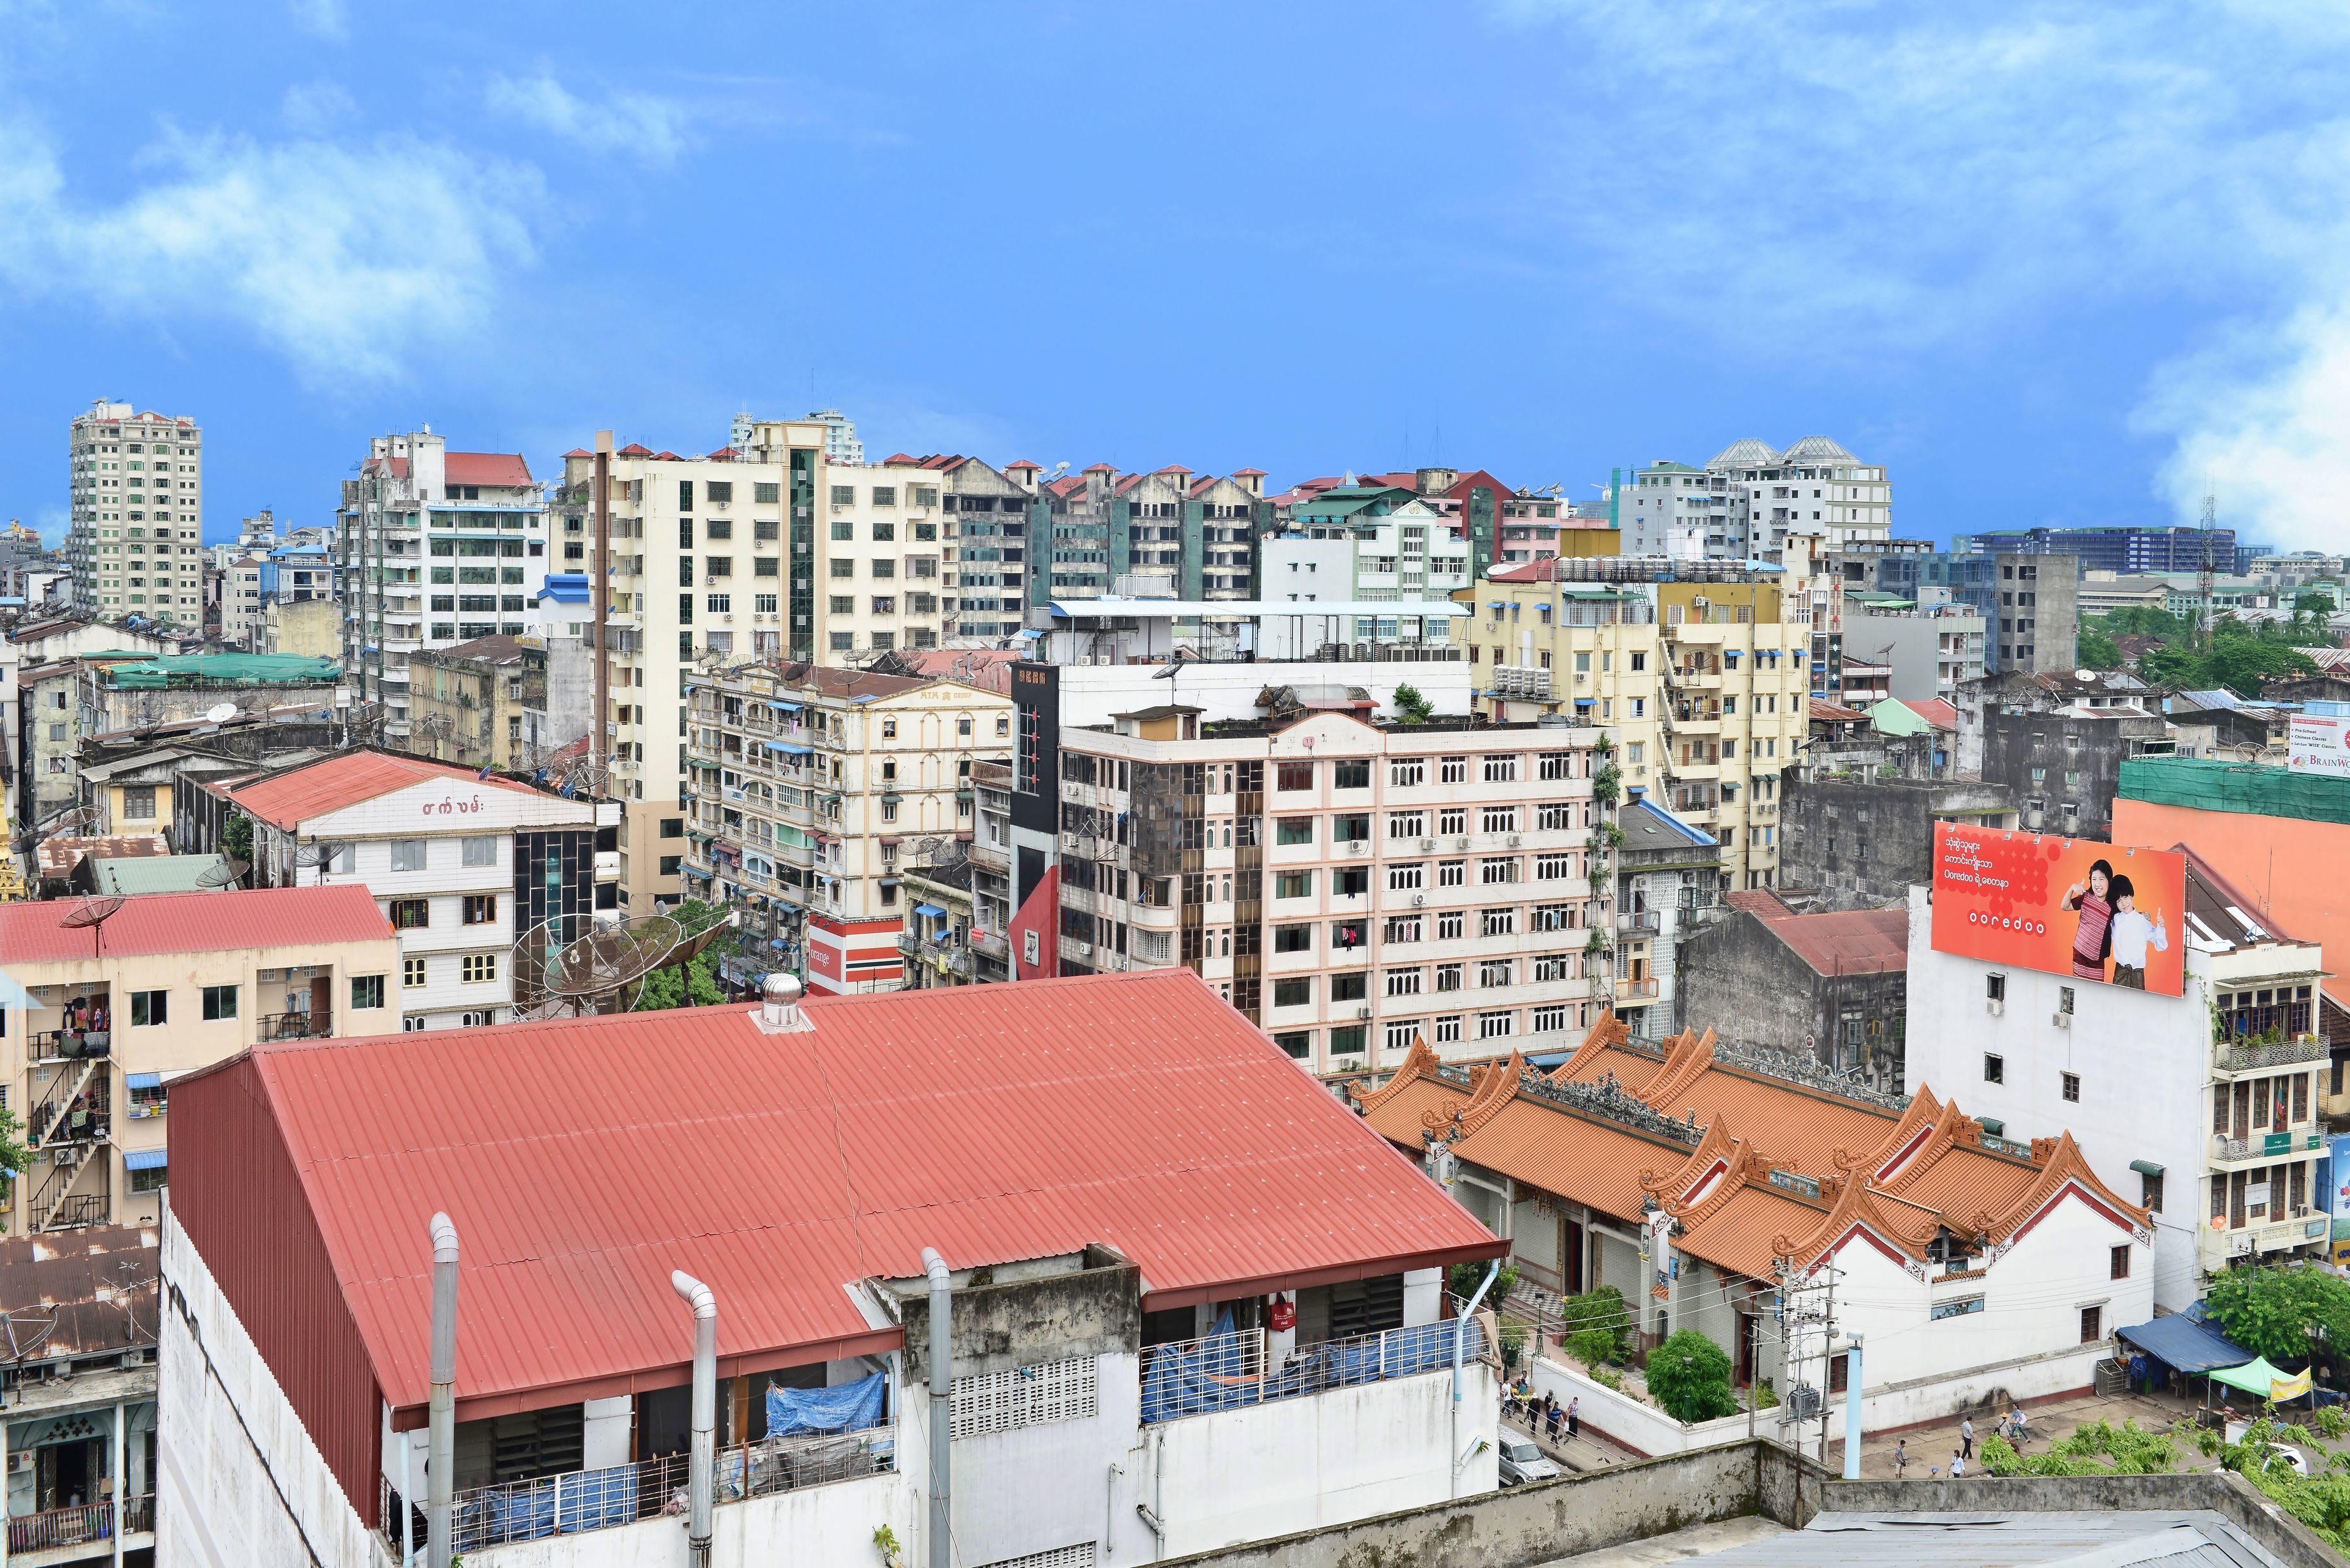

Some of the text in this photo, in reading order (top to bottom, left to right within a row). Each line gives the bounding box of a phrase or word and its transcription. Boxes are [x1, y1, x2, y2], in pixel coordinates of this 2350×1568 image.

[1944, 869, 1973, 883] Ooredoo
[1969, 912, 2045, 934] ooredoo
[810, 949, 830, 967] orange
